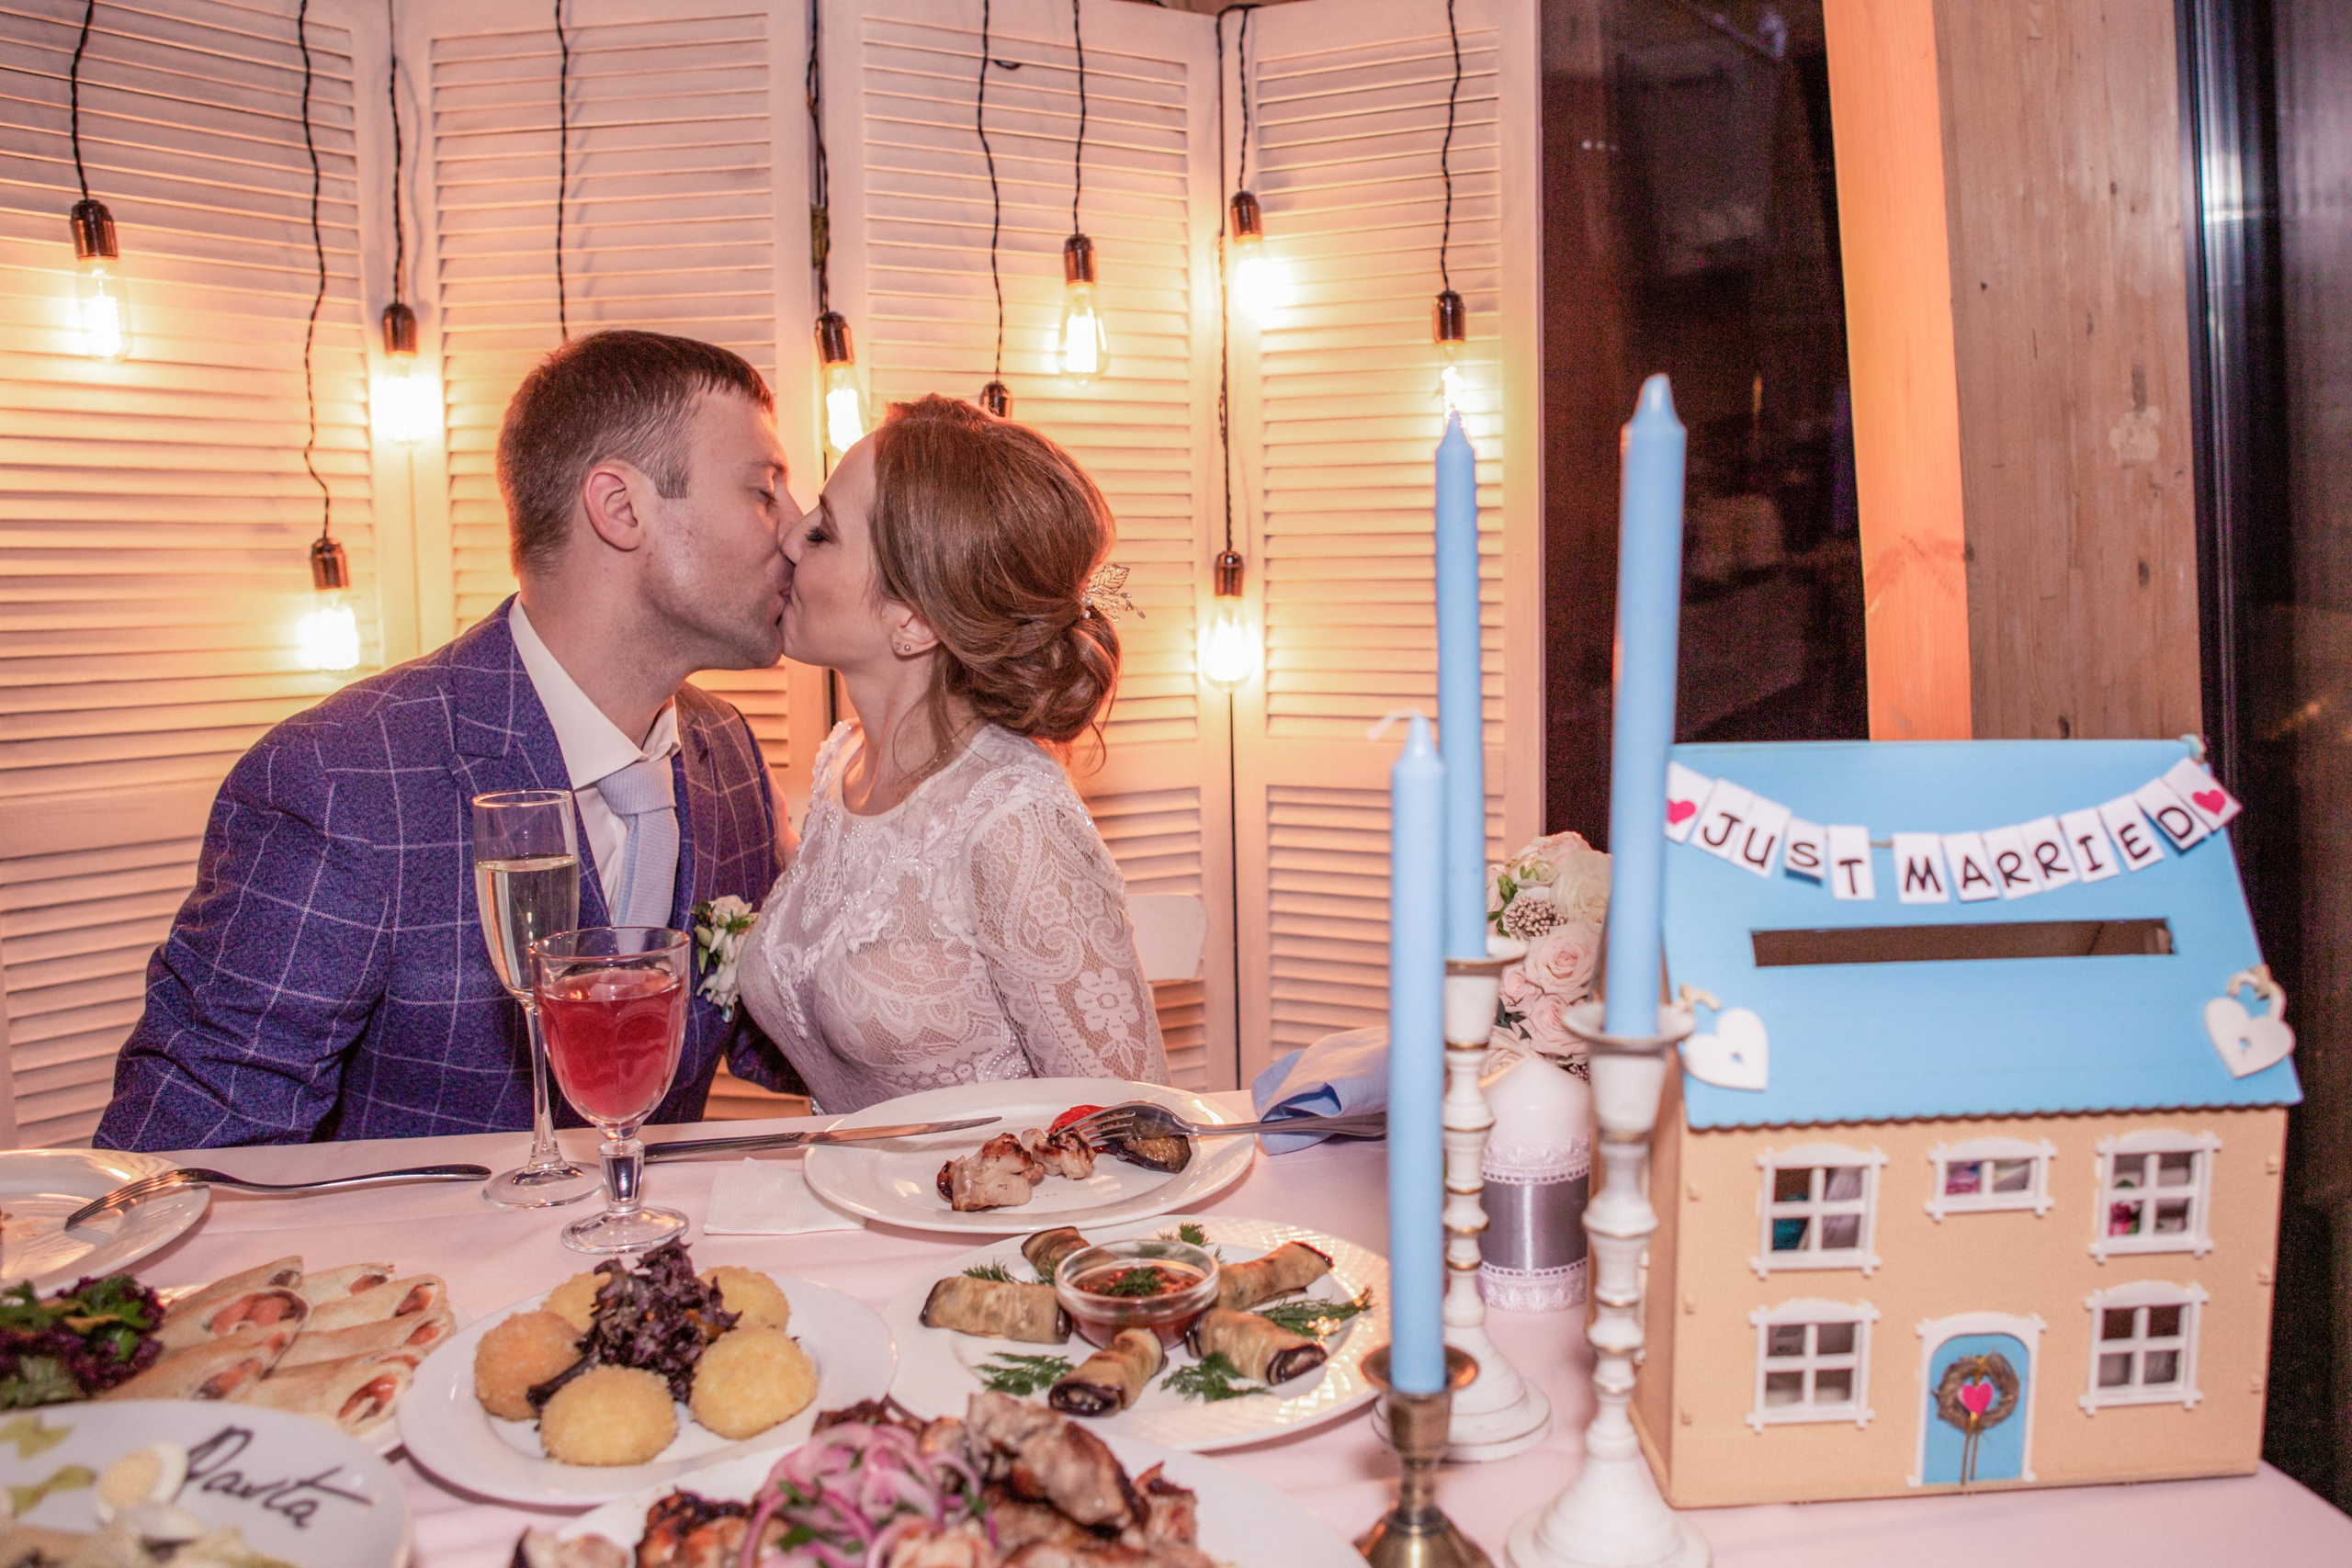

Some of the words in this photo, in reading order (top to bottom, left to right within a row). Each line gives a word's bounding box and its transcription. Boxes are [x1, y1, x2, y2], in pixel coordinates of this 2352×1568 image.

[1702, 812, 1863, 895] JUST
[1905, 806, 2194, 895] MARRIED
[172, 1426, 373, 1529] Pasta
